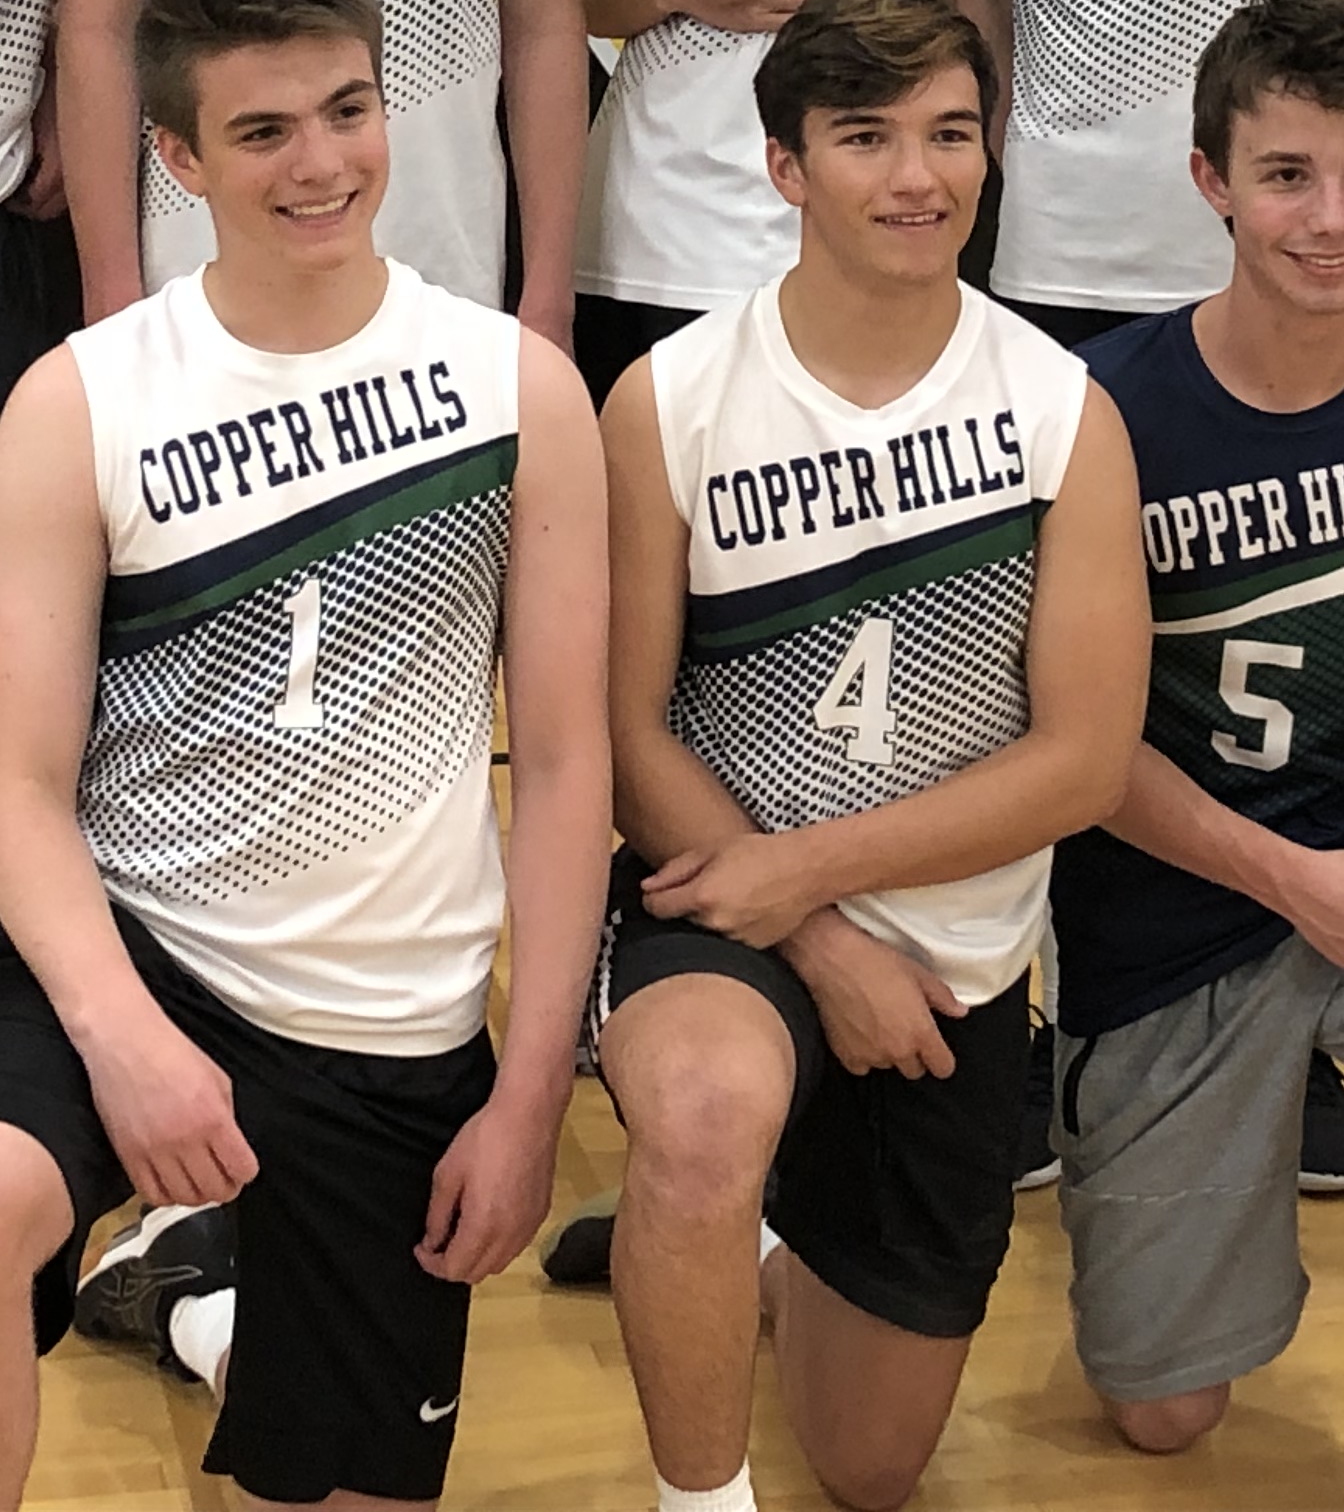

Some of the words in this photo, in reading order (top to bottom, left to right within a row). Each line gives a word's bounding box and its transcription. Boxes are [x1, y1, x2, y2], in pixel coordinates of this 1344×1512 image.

[140, 400, 326, 524] COPPER
[322, 360, 468, 466] HILLS
[707, 446, 885, 552] COPPER
[887, 408, 1026, 514] HILLS
[1141, 477, 1298, 574] OPPER
[272, 577, 326, 730] 1
[812, 616, 898, 767] 4
[1210, 638, 1305, 773] 5
